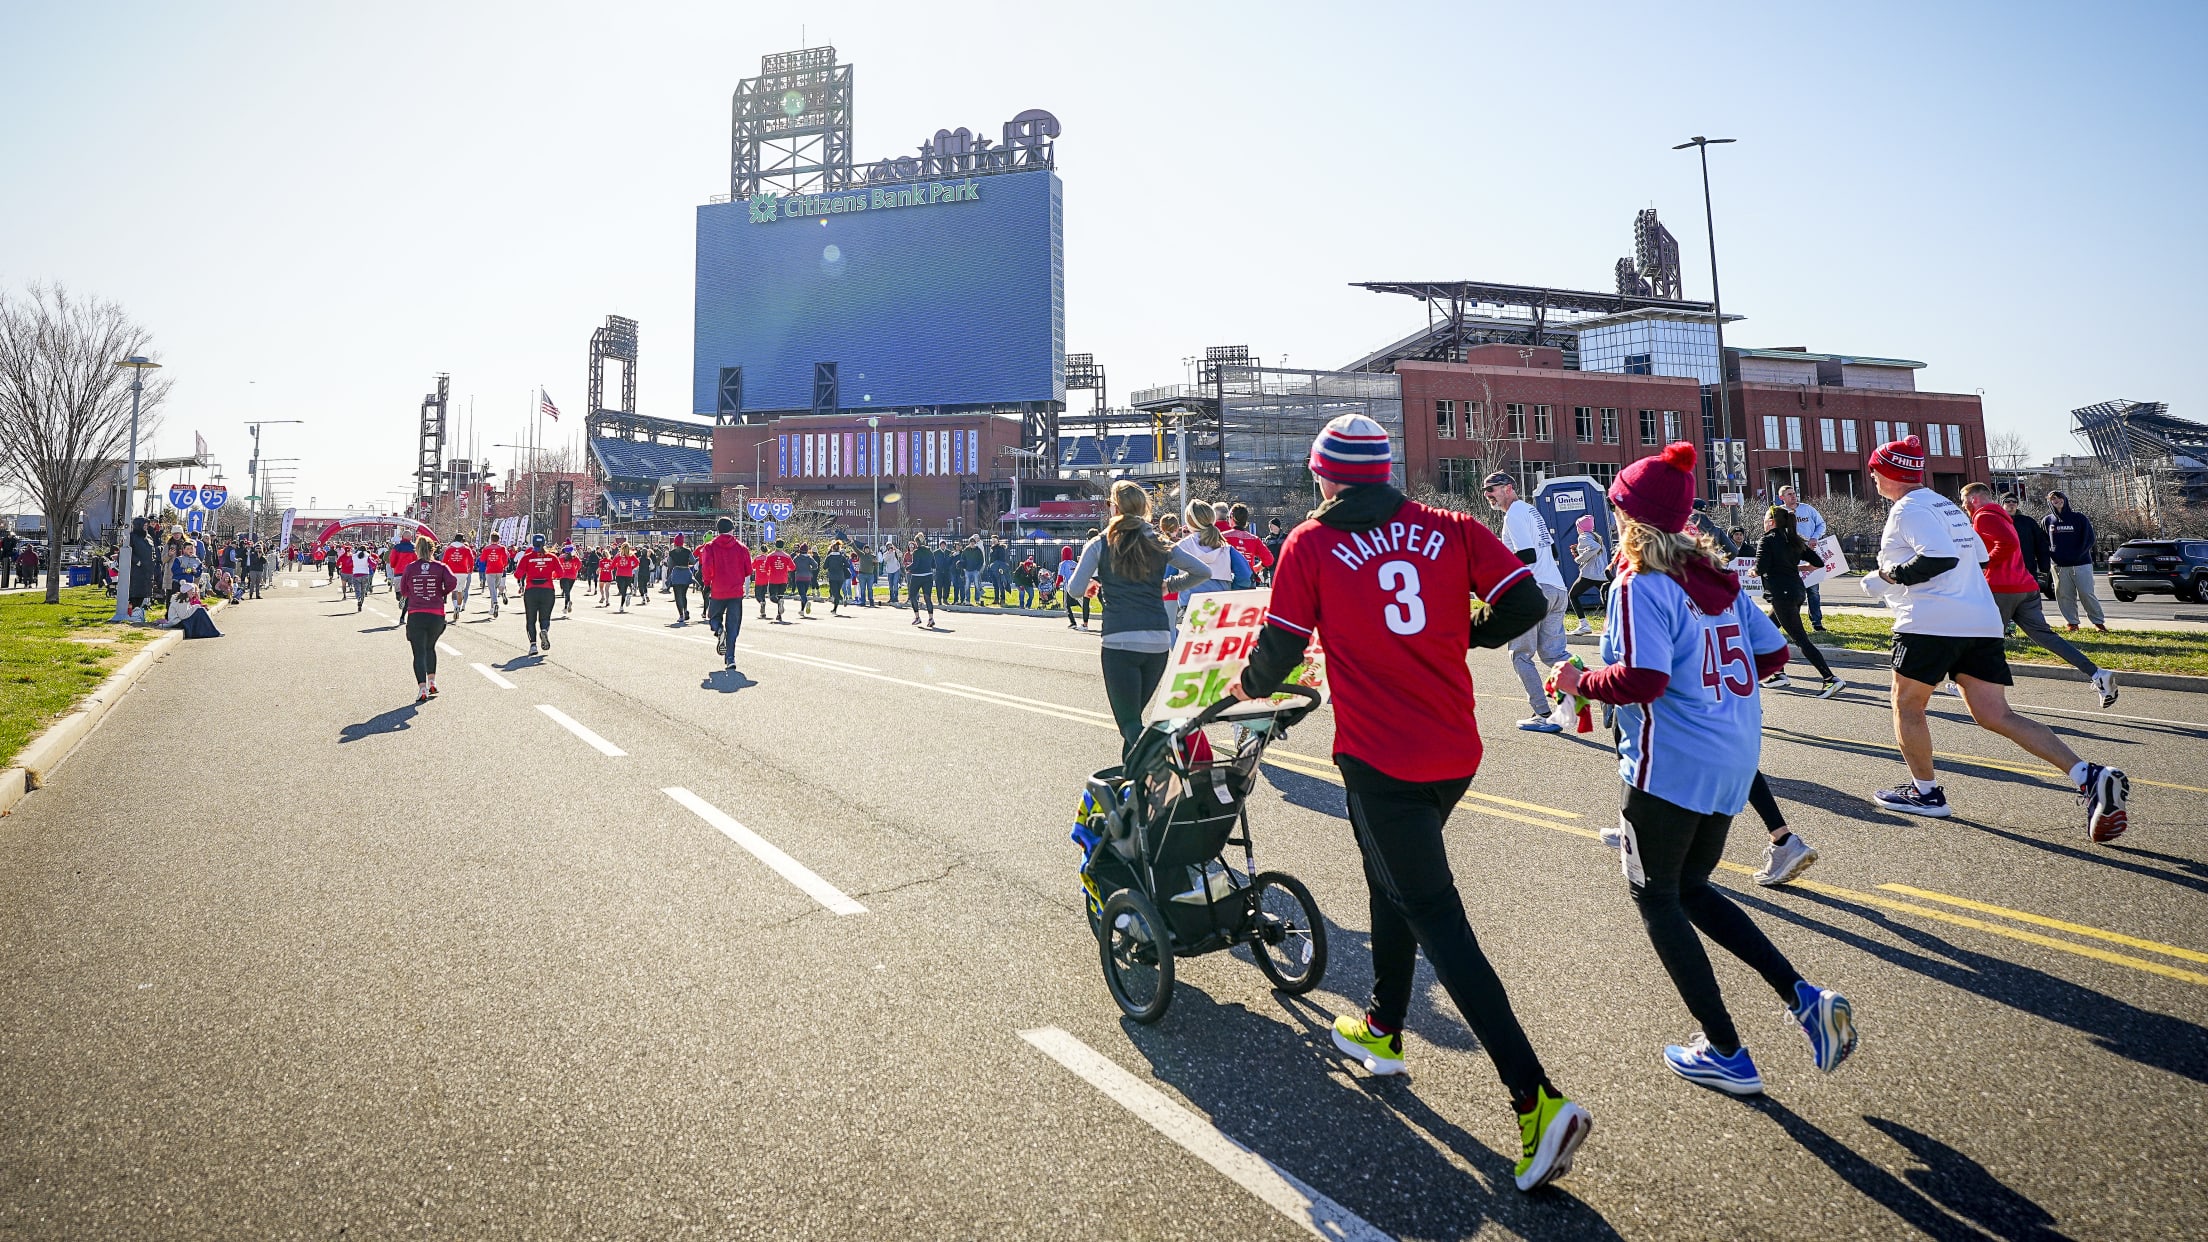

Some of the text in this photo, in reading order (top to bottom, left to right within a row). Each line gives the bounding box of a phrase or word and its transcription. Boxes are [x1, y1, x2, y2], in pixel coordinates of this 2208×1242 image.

[784, 177, 980, 218] Citizens Bank Park
[172, 490, 194, 505] 76
[202, 490, 223, 505] 95
[817, 499, 857, 507] HOME OF THE
[1557, 495, 1583, 504] United
[750, 503, 767, 516] 76
[772, 503, 790, 516] 95
[846, 508, 871, 517] PHILLIES
[1331, 522, 1445, 571] HARPER
[1378, 560, 1427, 636] 3
[1701, 622, 1755, 703] 45
